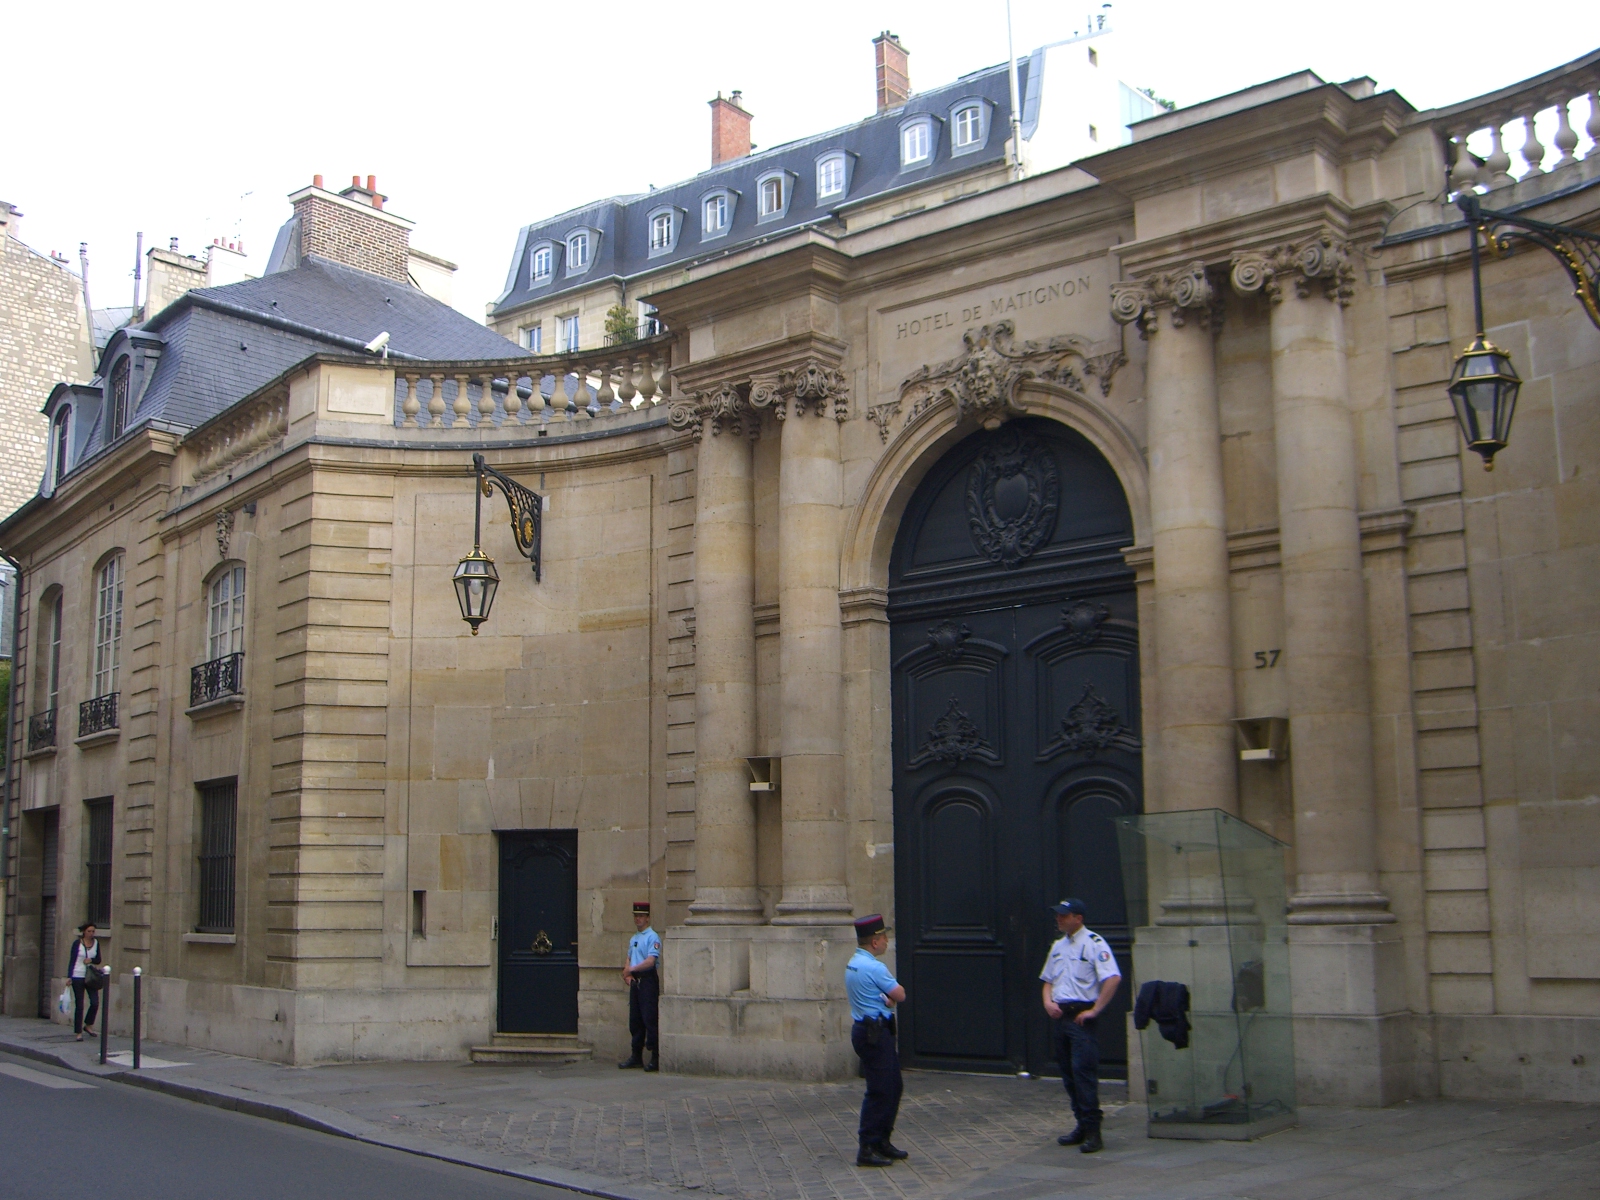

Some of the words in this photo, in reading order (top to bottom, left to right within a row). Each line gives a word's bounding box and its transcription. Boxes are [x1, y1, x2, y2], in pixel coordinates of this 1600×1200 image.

[896, 311, 954, 340] HOTEL
[962, 305, 982, 324] DE
[990, 275, 1091, 317] MATIGNON
[1254, 649, 1282, 669] 57
